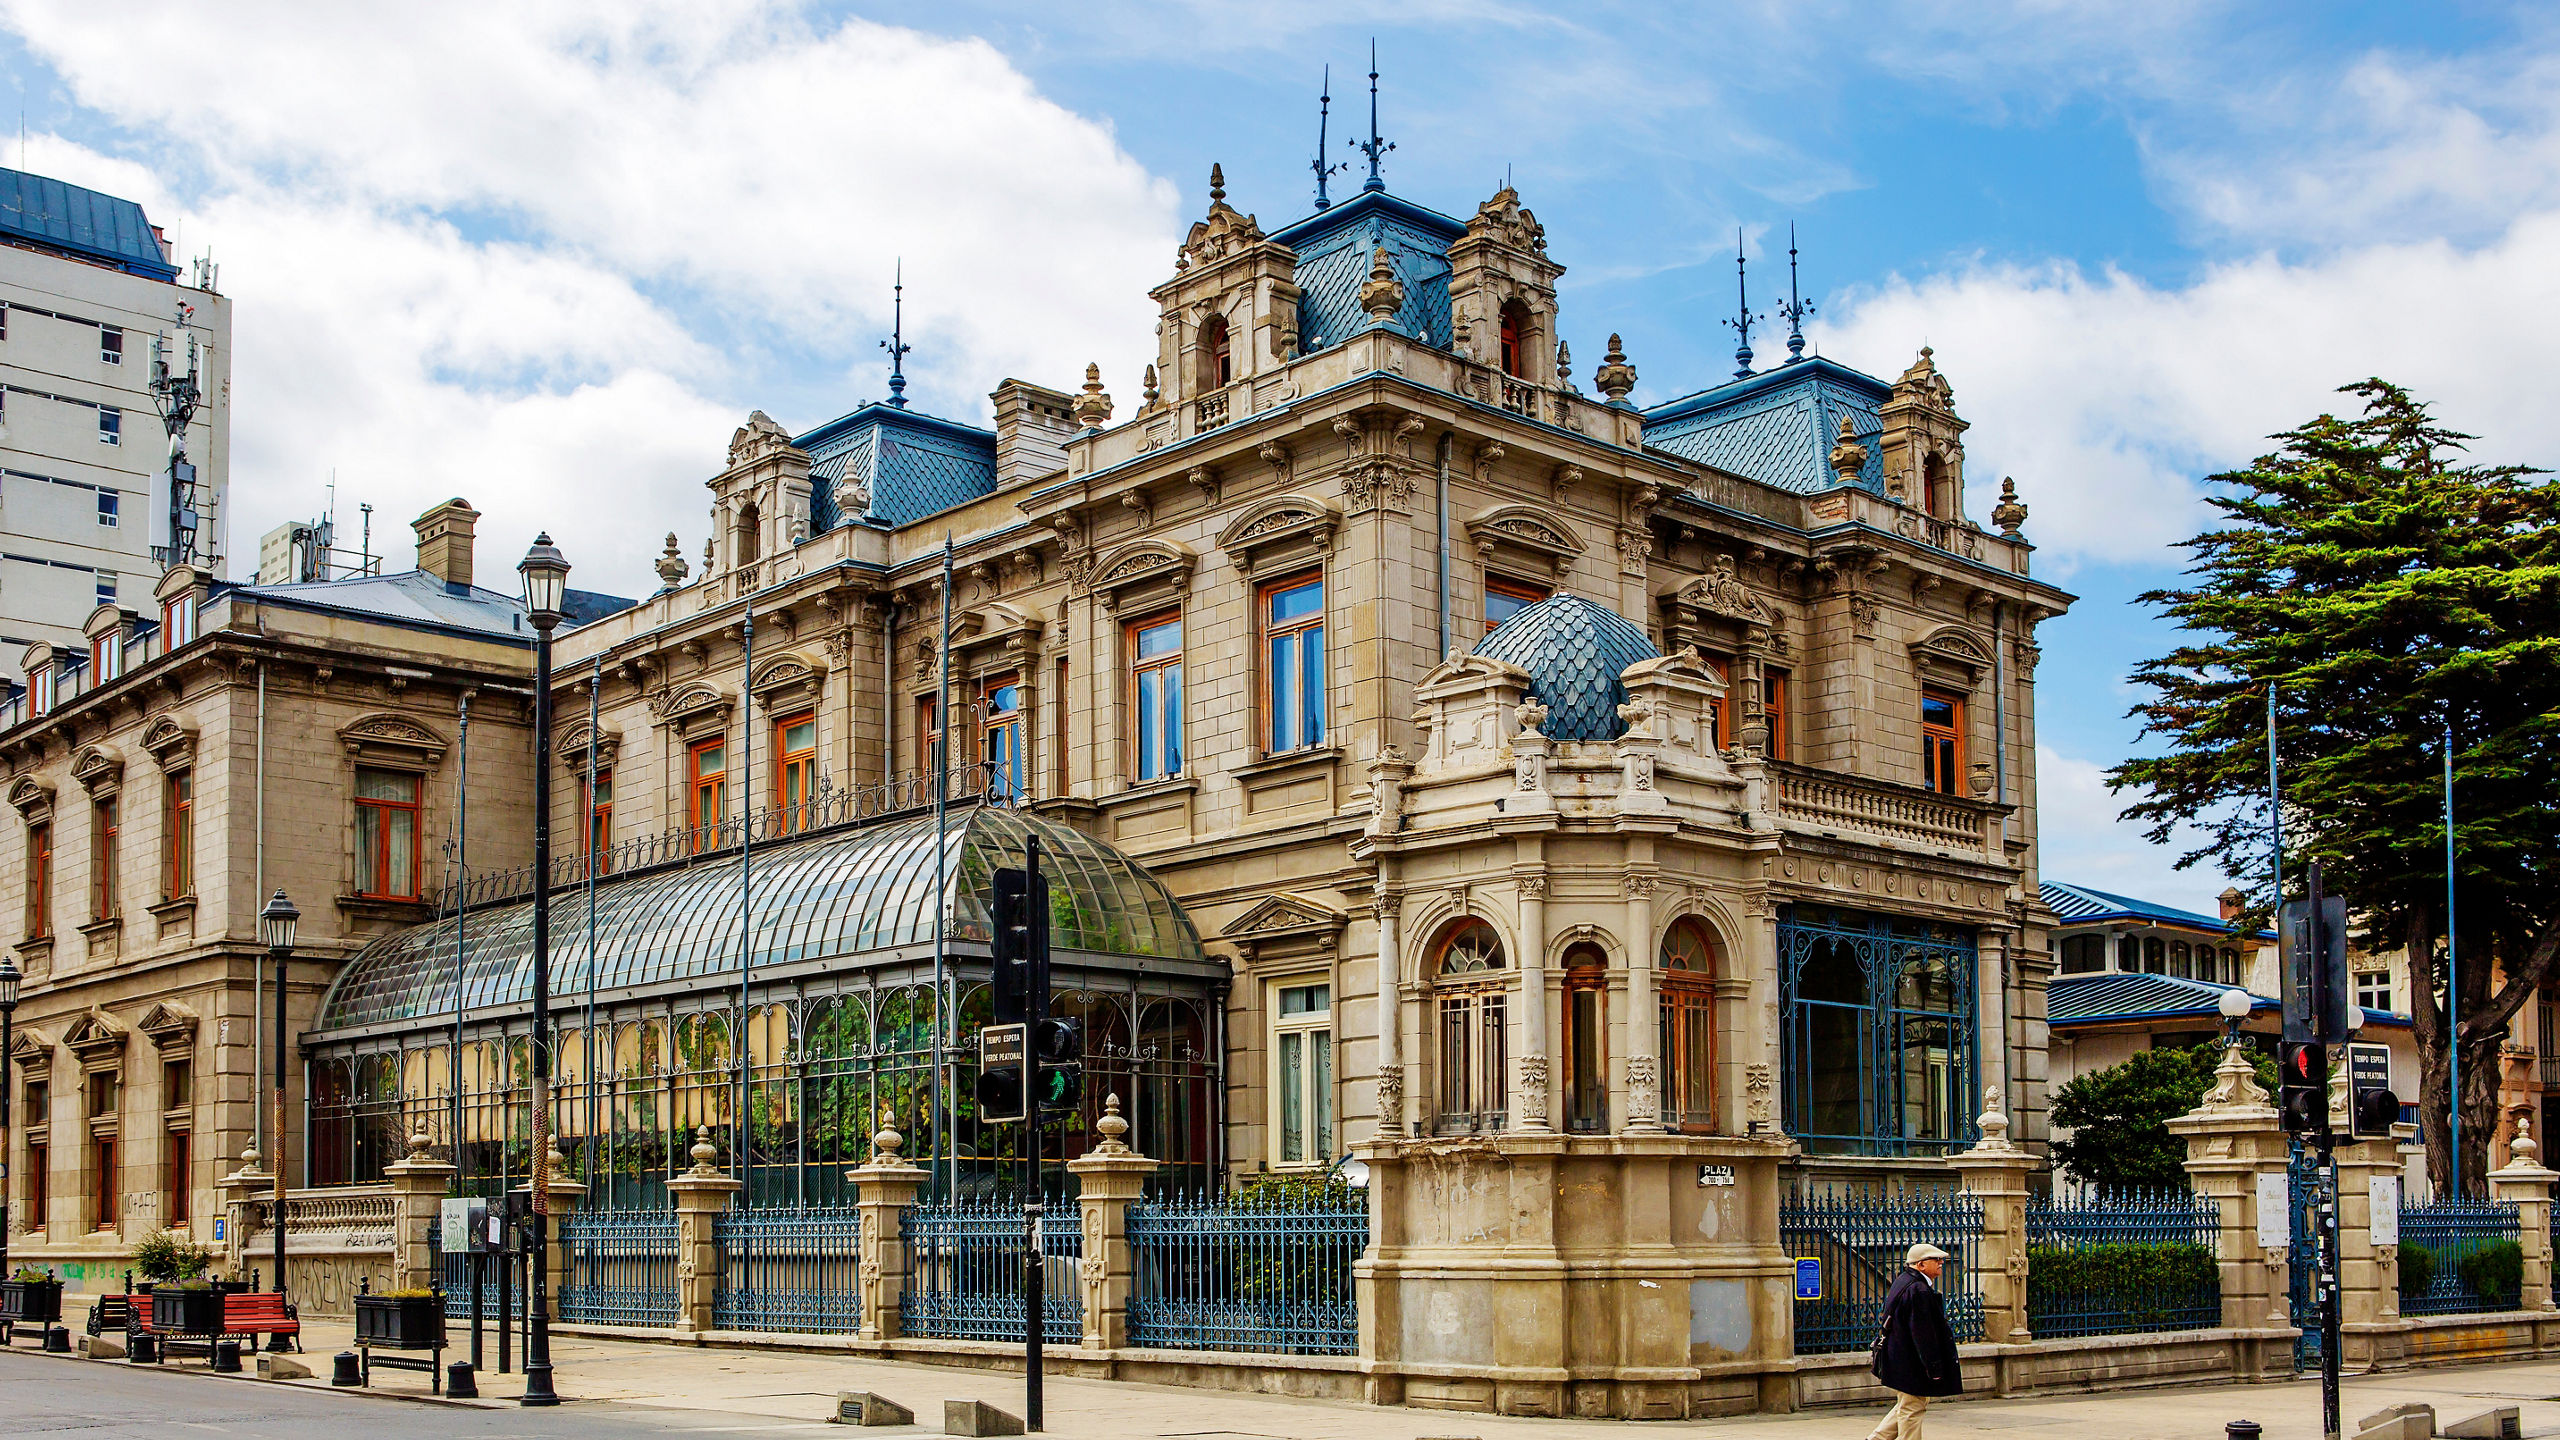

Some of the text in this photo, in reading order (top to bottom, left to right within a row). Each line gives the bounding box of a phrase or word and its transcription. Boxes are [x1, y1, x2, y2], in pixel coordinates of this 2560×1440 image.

[986, 1034, 1020, 1044] TIEMPO ESPERA
[985, 1052, 1022, 1062] VERDE PEATONAL
[2354, 1055, 2386, 1064] TIEMPO ESPERA
[2354, 1071, 2387, 1080] VERDE PEATONAL
